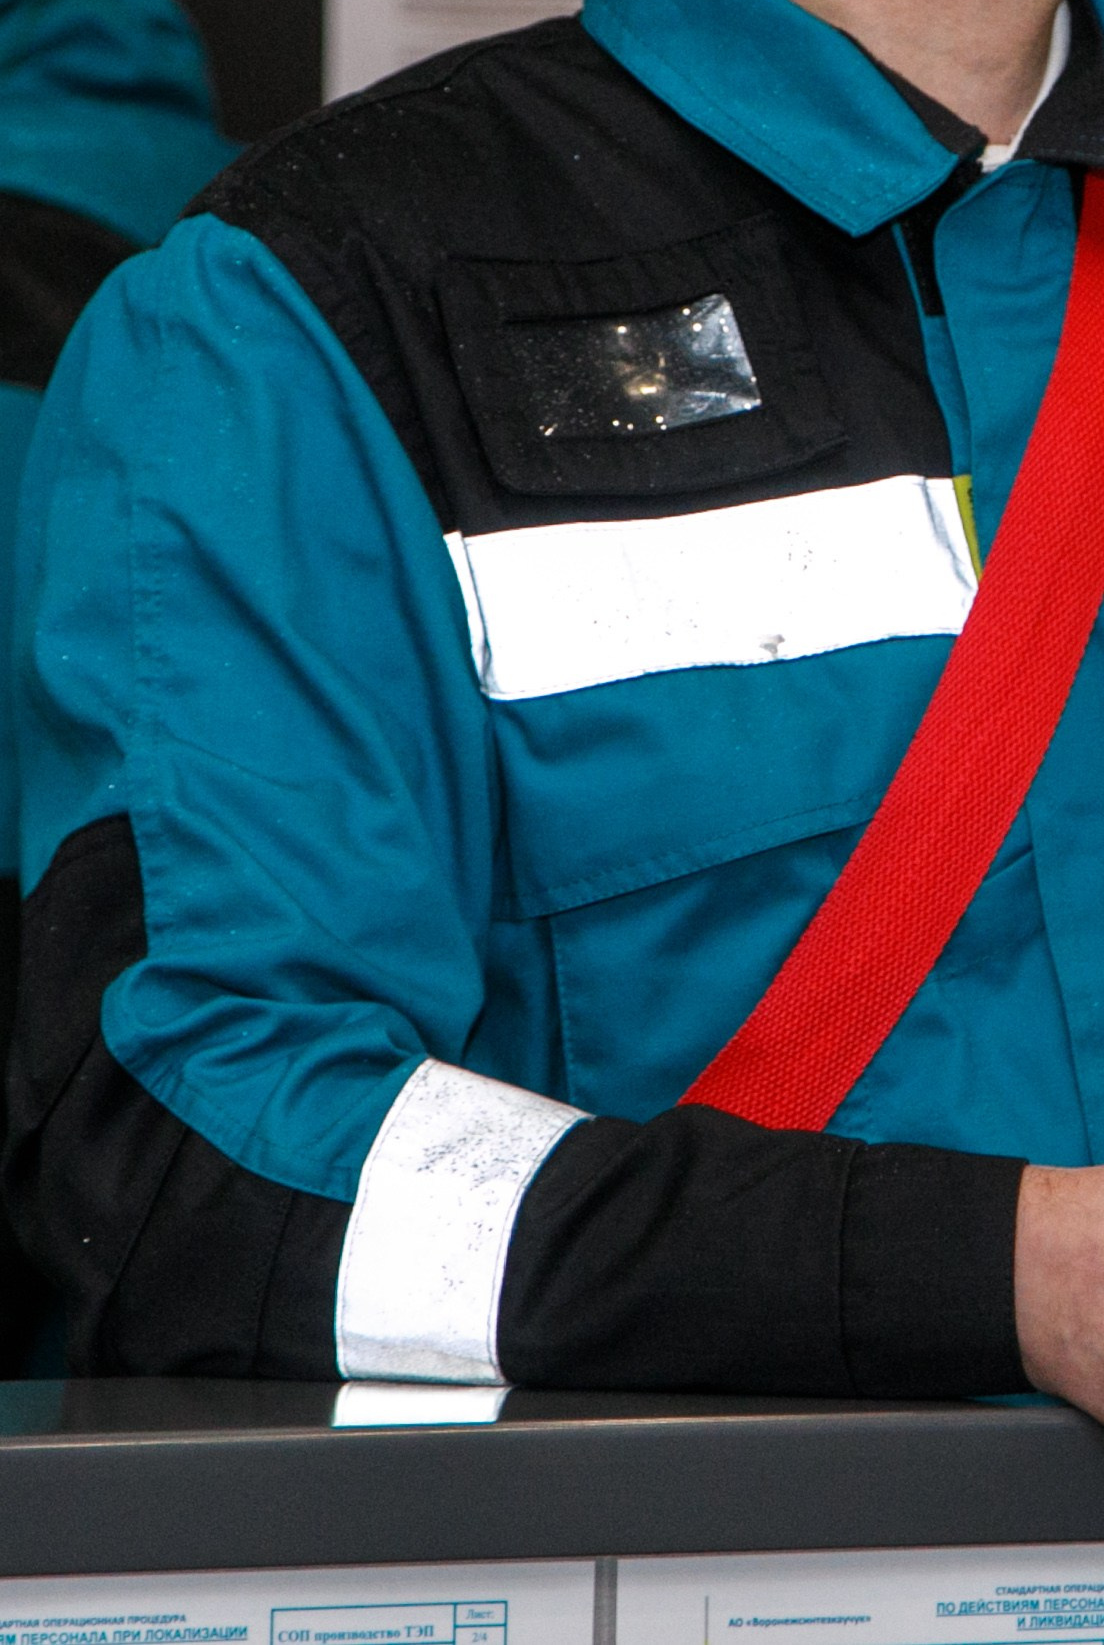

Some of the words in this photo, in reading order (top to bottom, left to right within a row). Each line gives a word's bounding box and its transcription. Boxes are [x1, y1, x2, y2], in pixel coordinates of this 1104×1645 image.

[996, 1585, 1060, 1595] СТАНДАРТНАЯ
[937, 1602, 955, 1614] ПО
[960, 1598, 1039, 1615] ДЕЙСТВИЯМ
[0, 1619, 39, 1630] АРТНАЯ
[43, 1616, 125, 1627] ОПЕРАЦИОННАЯ
[127, 1614, 187, 1625] ПРОЦЕДУРА
[728, 1618, 743, 1628] АО
[1017, 1616, 1026, 1628] И
[22, 1631, 107, 1644] ПЕРСОНАЛА
[113, 1630, 141, 1642] ПРИ
[145, 1626, 247, 1641] ЛОКАЛИЗАЦИИ
[278, 1630, 310, 1643] СОП
[314, 1628, 401, 1643] производство
[405, 1625, 434, 1638] ТЭП
